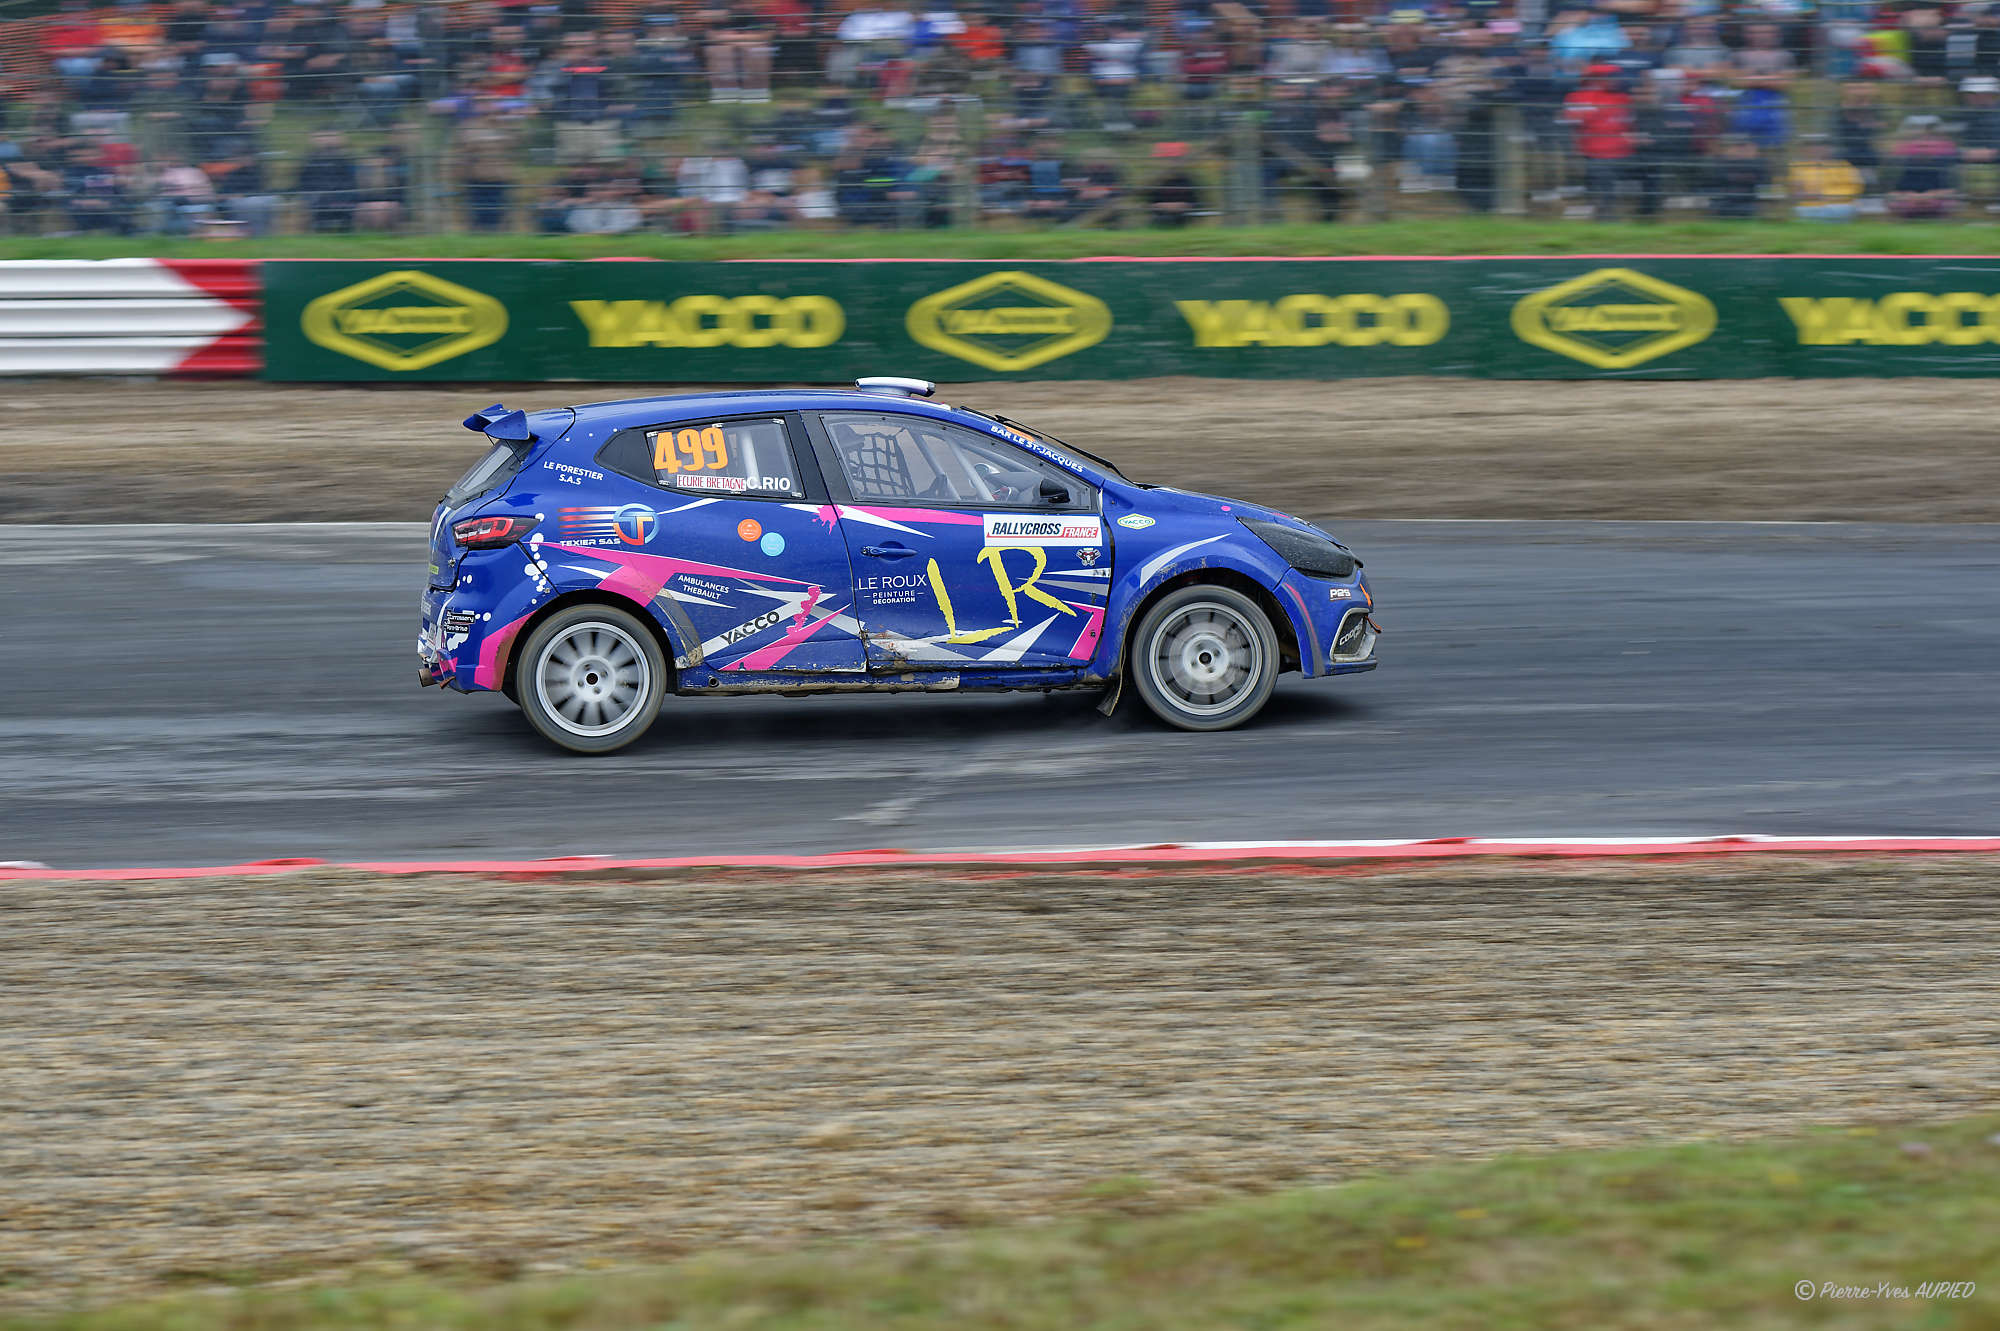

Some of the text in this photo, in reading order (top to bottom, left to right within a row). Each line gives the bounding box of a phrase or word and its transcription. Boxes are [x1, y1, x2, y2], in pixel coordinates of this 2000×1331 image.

[570, 295, 846, 348] YACCO
[1174, 293, 1449, 347] YACCO
[1777, 292, 2000, 346] YACC
[653, 427, 728, 474] 499
[991, 425, 1083, 473] BAR LE ST-JACQUES
[543, 461, 604, 481] LE FORESTIER
[558, 474, 582, 486] S.A.S
[677, 475, 745, 490] ECURIE BRETAGNE
[746, 476, 791, 491] C.RIO
[992, 522, 1097, 538] RALLYCROSS FRANCE
[560, 539, 596, 547] TEXIER
[677, 575, 730, 594] AMBULANCES
[858, 574, 927, 590] LE ROUX
[683, 584, 721, 600] THEBAULT
[872, 590, 916, 598] PEINTURE
[720, 611, 780, 645] YACCO
